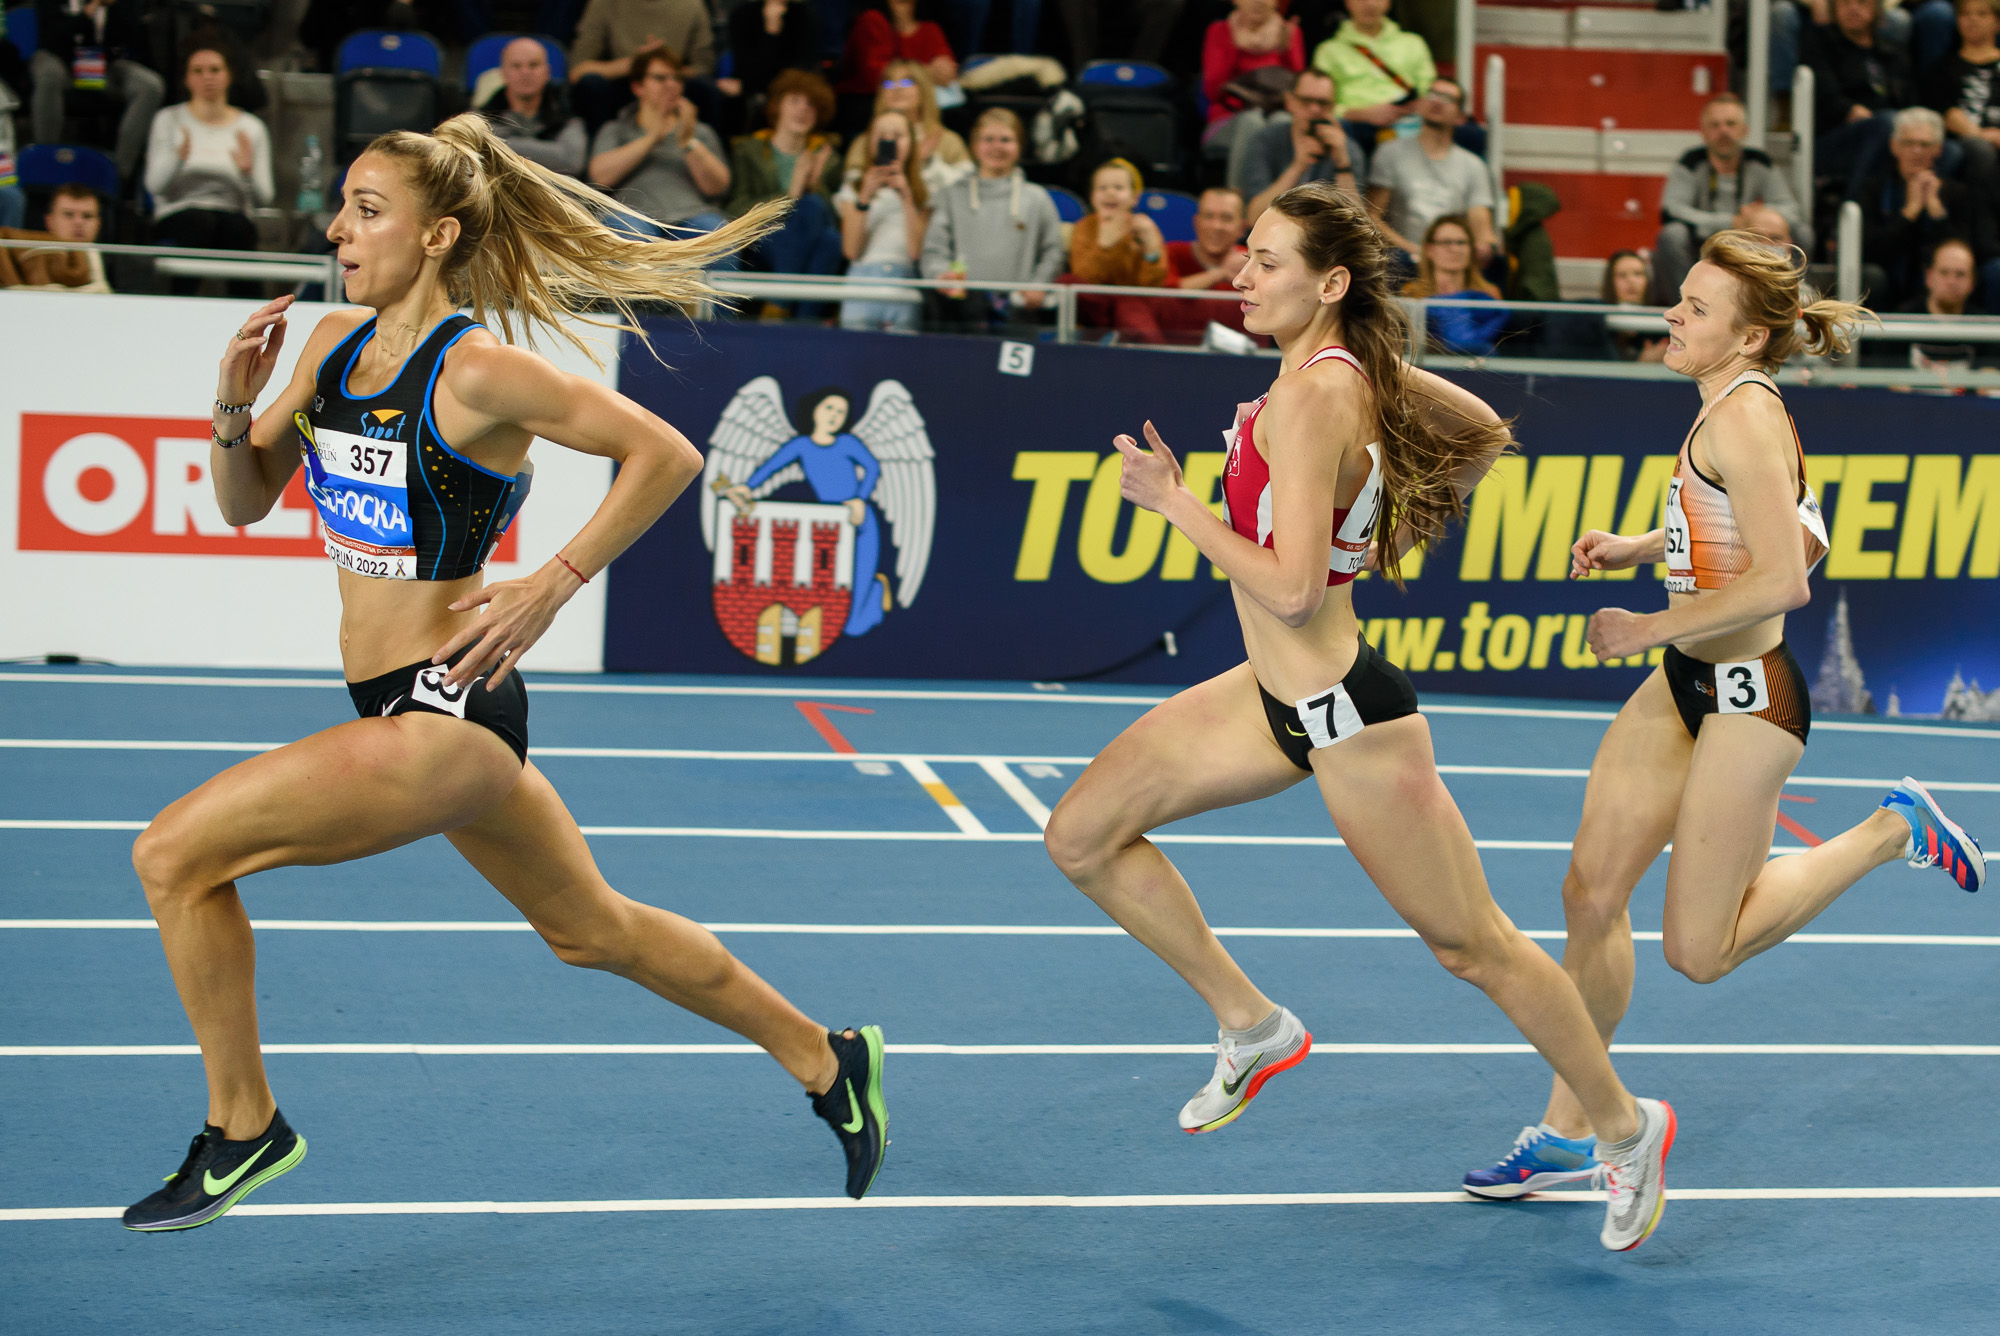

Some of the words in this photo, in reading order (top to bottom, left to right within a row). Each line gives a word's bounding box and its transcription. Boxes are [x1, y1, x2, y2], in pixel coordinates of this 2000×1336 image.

[1008, 346, 1024, 369] 5
[318, 448, 337, 462] RUŃ
[350, 444, 393, 477] 357
[356, 557, 389, 576] 2022
[1726, 666, 1757, 709] 3
[1306, 691, 1339, 741] 7
